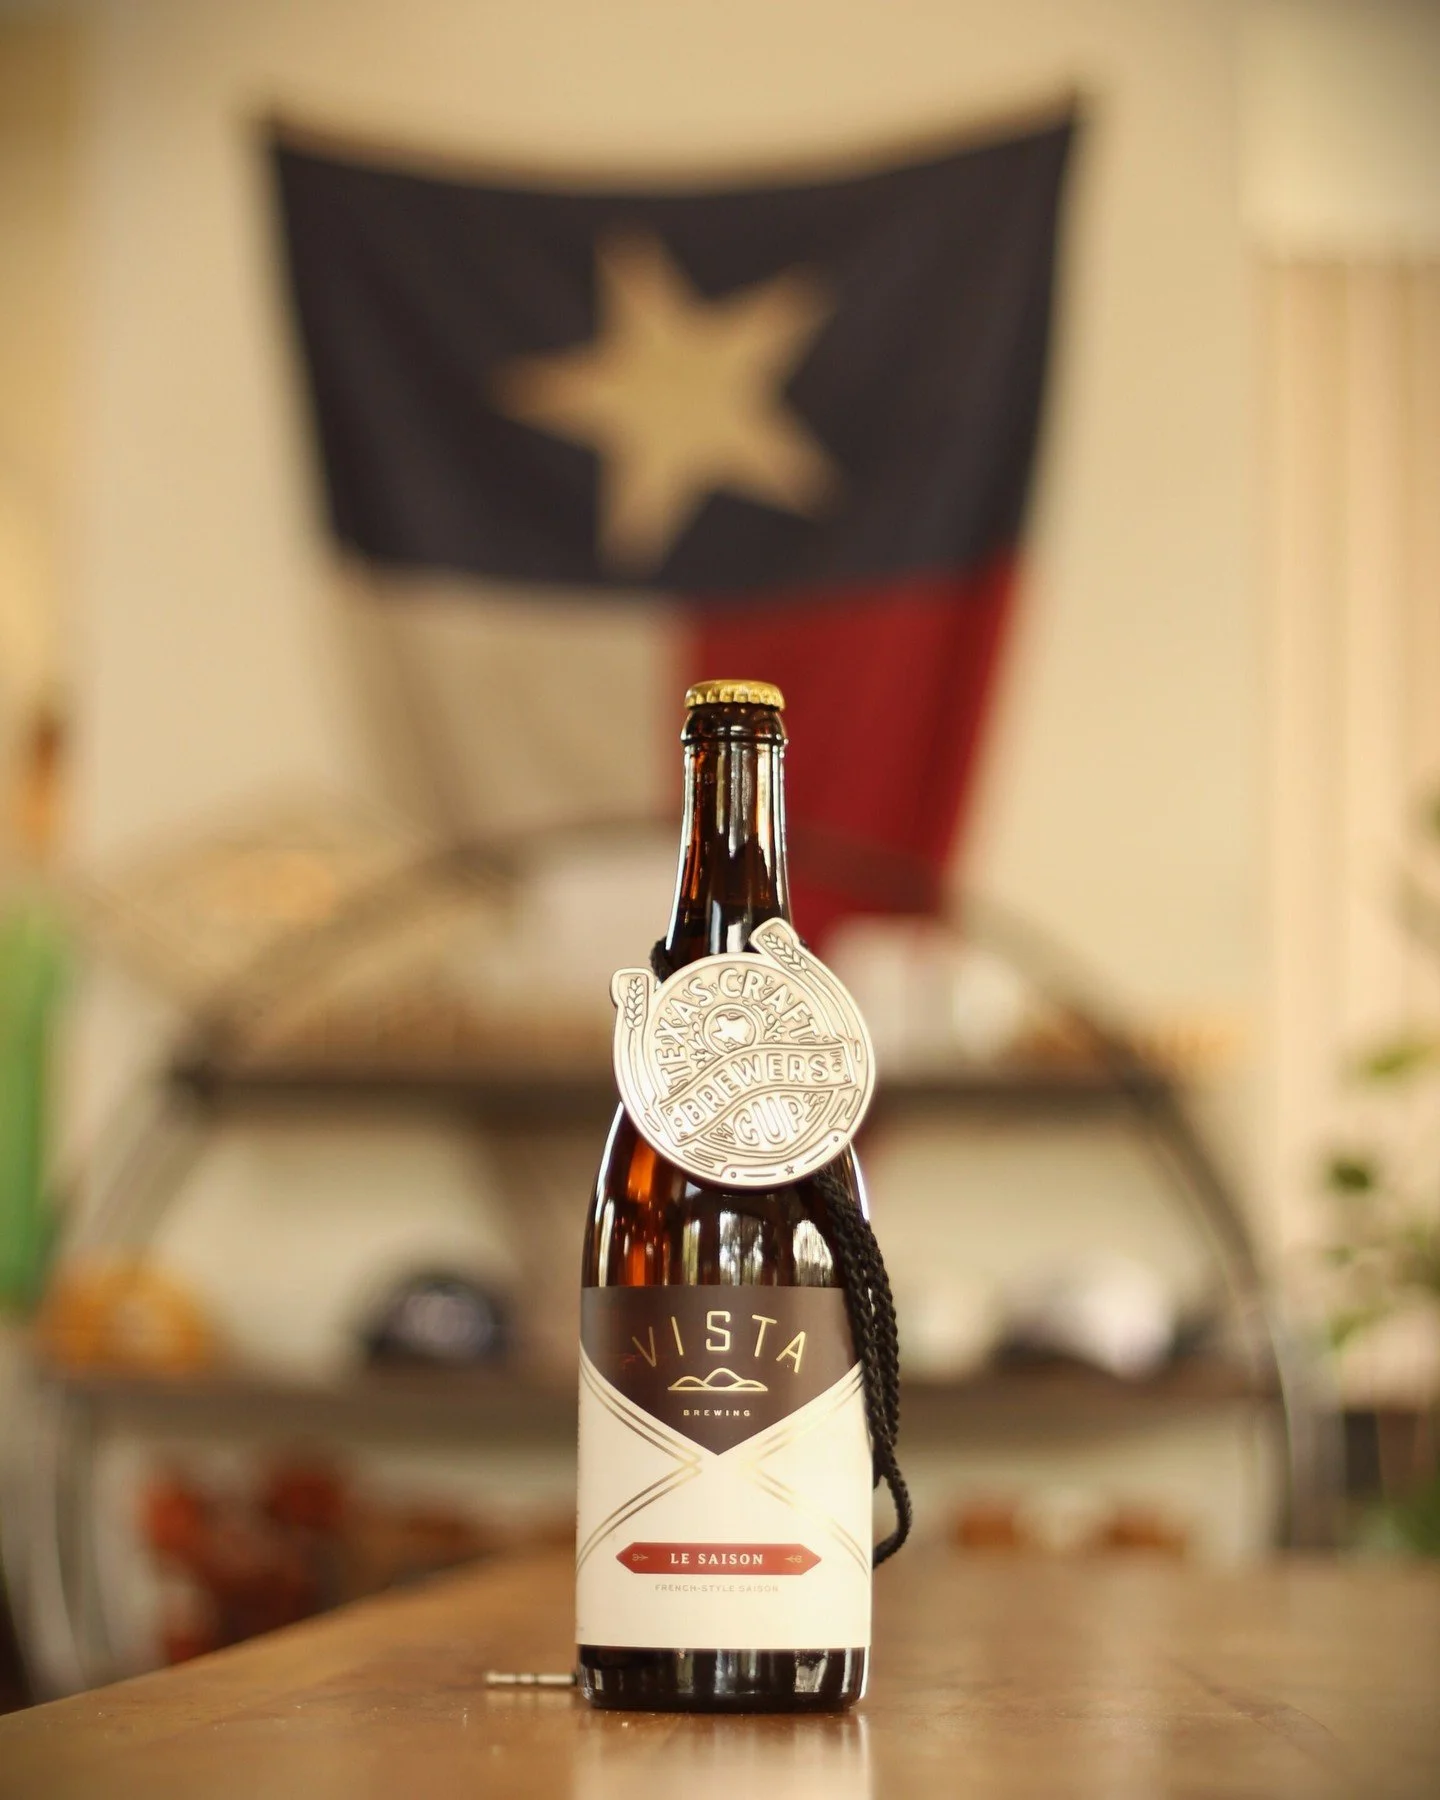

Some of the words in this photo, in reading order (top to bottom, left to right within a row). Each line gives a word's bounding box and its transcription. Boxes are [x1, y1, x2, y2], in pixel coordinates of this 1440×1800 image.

[654, 978, 715, 1088] TEXAS
[717, 967, 819, 1040] CRAFT
[680, 1054, 830, 1127] BREWERS
[733, 1095, 805, 1146] CUP
[632, 1310, 806, 1373] VISTA
[683, 1409, 751, 1418] BREWING
[669, 1553, 690, 1565] LE
[698, 1553, 764, 1565] SAISON
[655, 1584, 734, 1593] FRENCH-STYLE
[738, 1584, 779, 1593] SAISON
